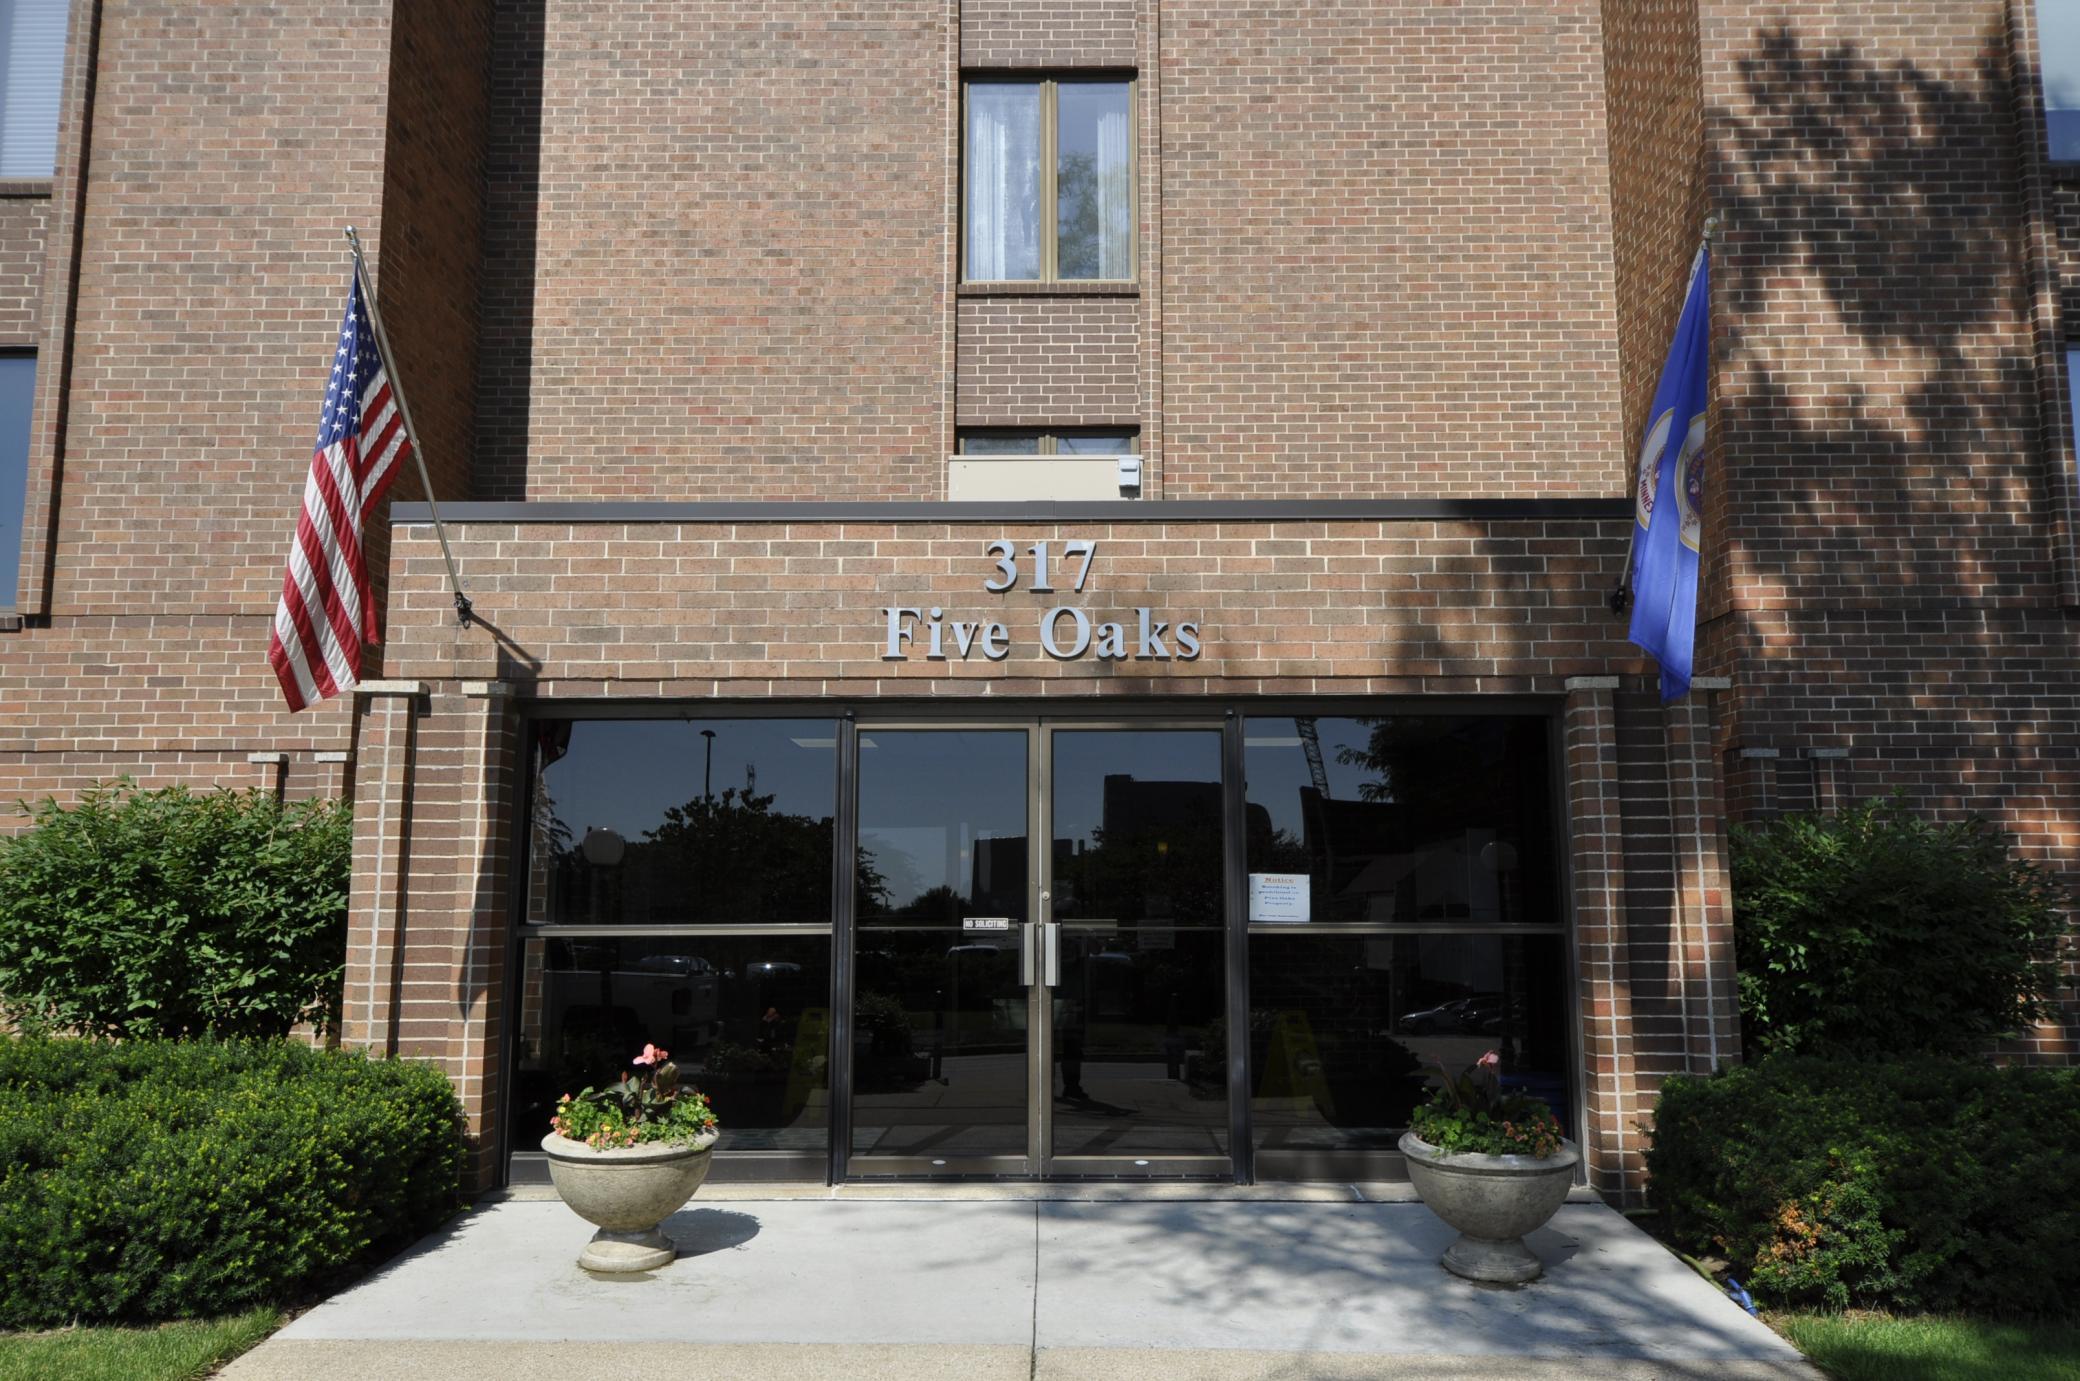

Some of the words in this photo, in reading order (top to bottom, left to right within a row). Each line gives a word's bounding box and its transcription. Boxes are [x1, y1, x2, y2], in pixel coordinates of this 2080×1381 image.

[984, 539, 1097, 594] 317
[882, 607, 1010, 661] Five
[1040, 606, 1201, 661] Oaks
[965, 920, 974, 928] NO
